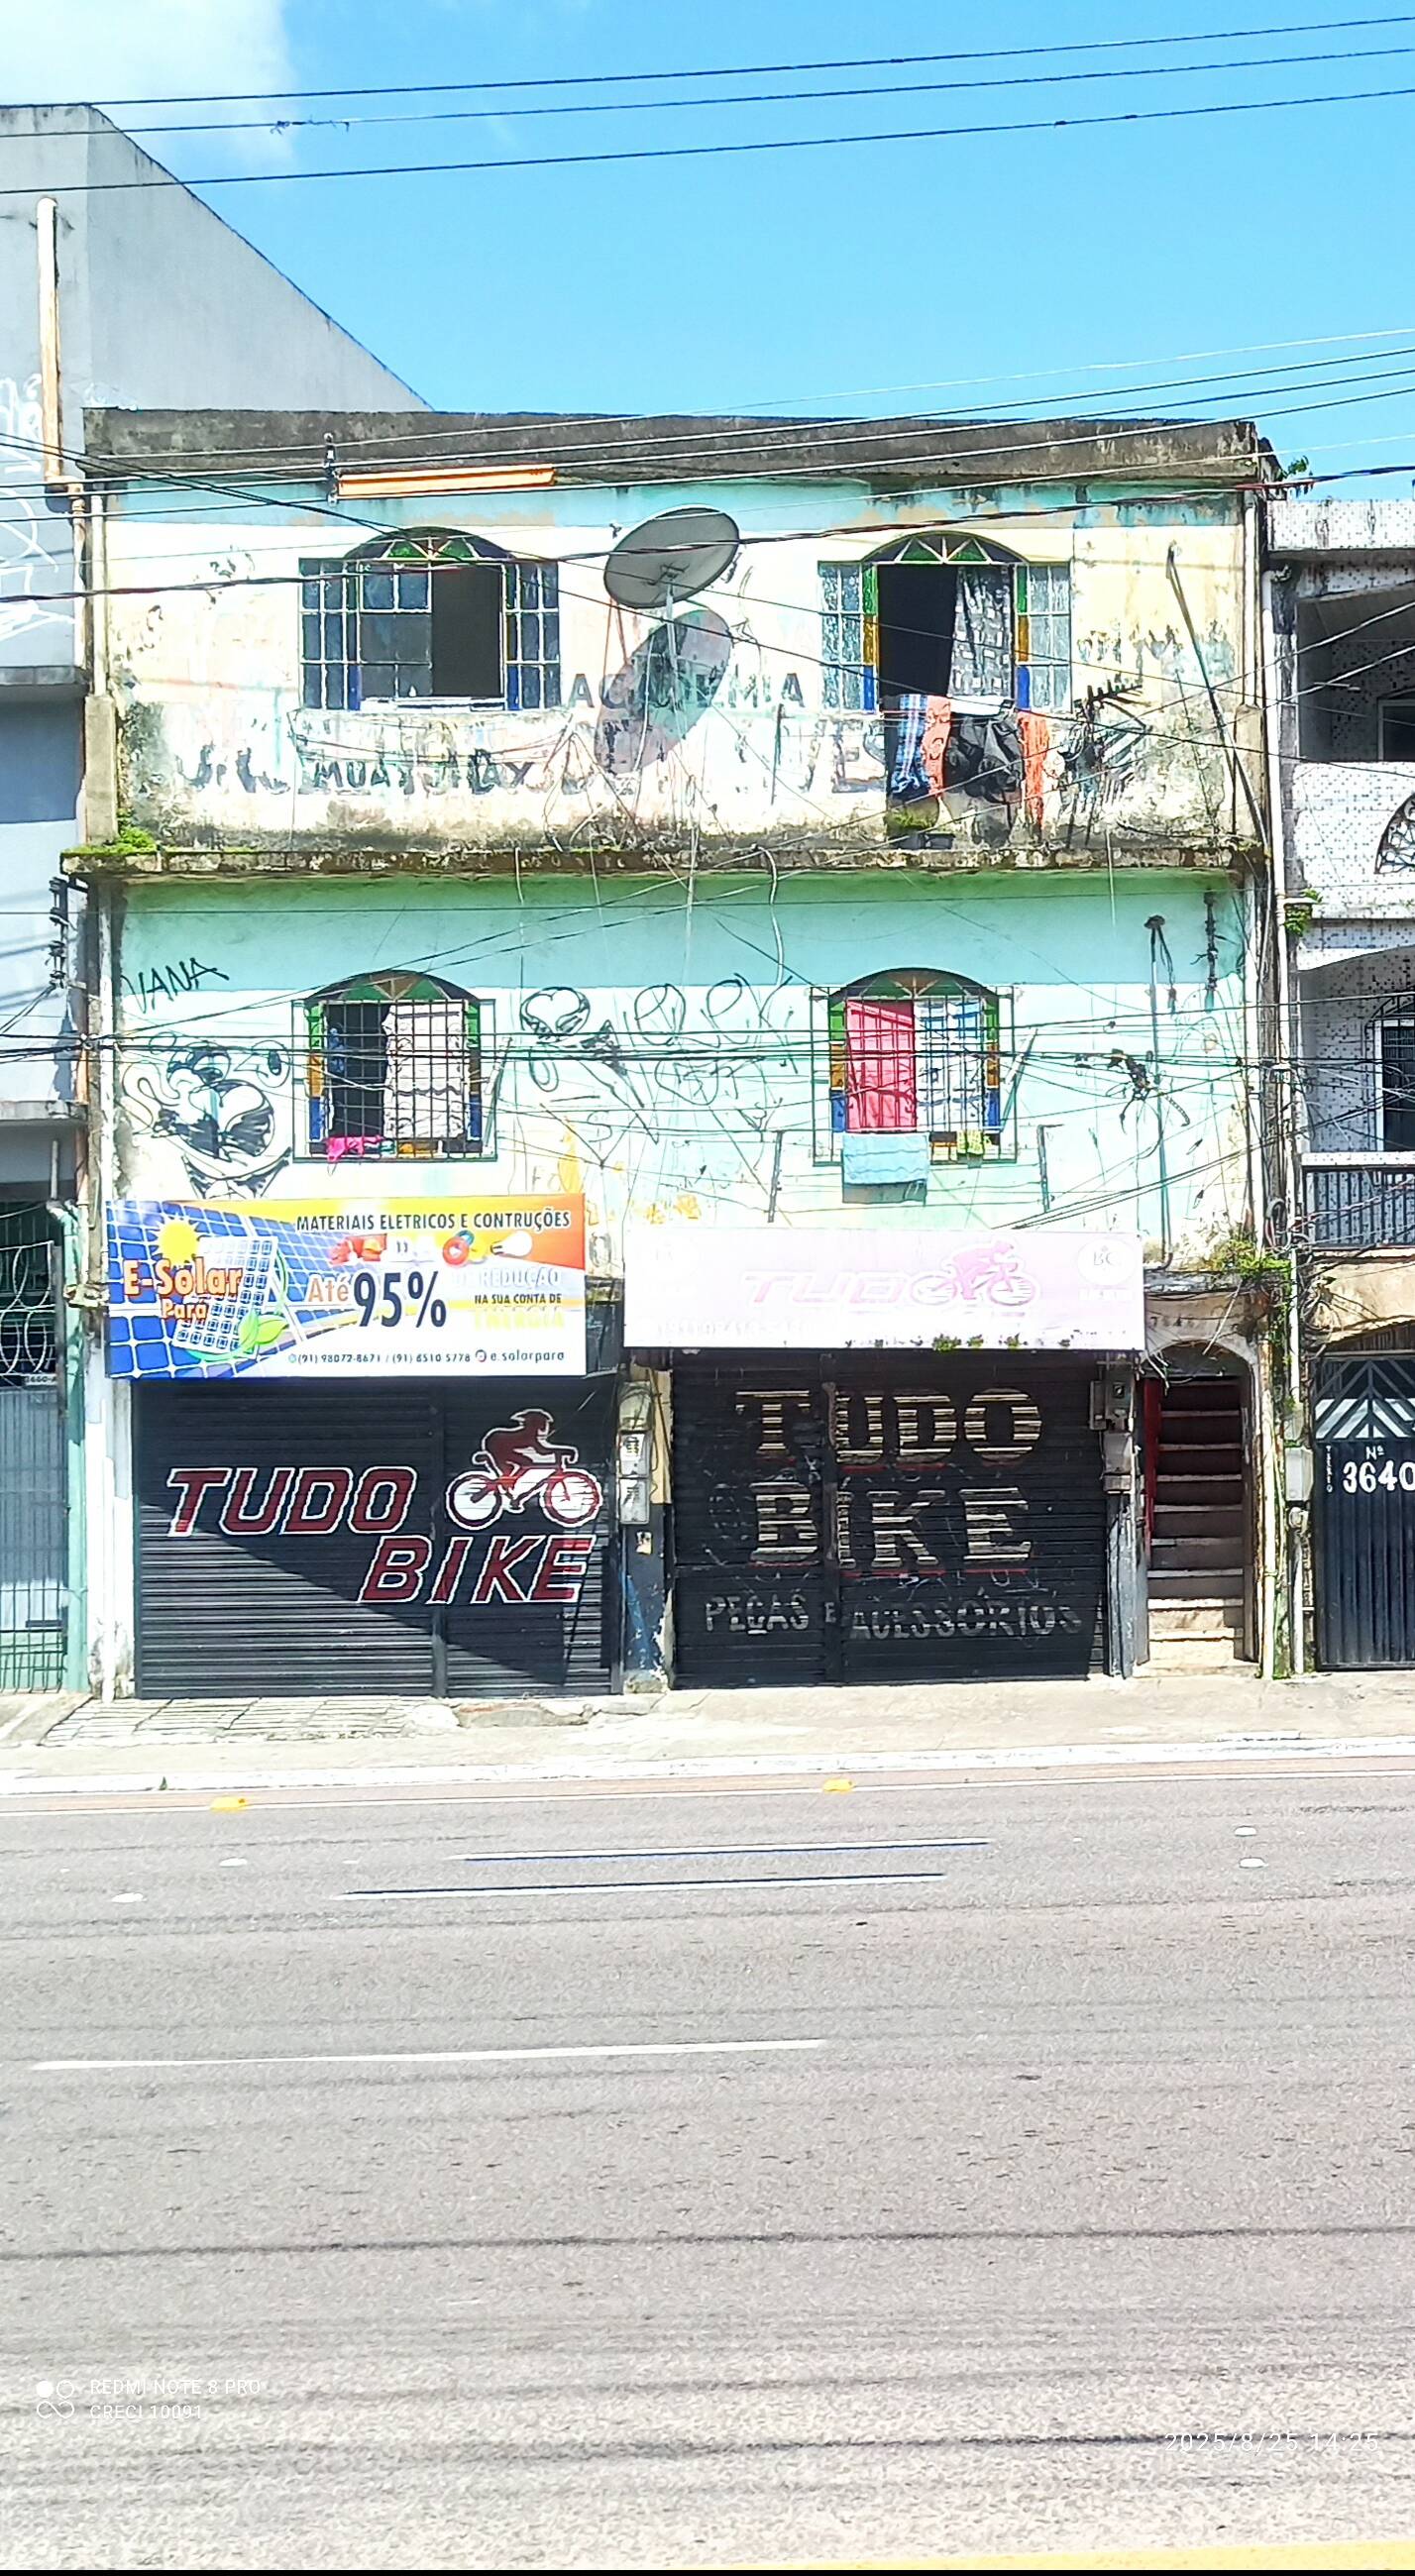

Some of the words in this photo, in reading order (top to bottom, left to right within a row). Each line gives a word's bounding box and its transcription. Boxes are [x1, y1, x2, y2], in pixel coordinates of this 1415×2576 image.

[296, 1215, 375, 1232] MATERIAIS
[380, 1213, 455, 1230] ELETRICOS
[461, 1213, 468, 1228] E
[474, 1207, 571, 1232] CONTRUÇÕES
[122, 1255, 244, 1297] E-Solar
[307, 1275, 349, 1303] Até
[353, 1270, 447, 1329] 95%
[474, 1294, 489, 1304] NA
[490, 1294, 510, 1304] SUA
[512, 1293, 546, 1304] CONTA
[549, 1293, 562, 1304] DE
[736, 1388, 1042, 1468] TUDO
[166, 1465, 417, 1537] TUDO
[1343, 1459, 1415, 1494] 3640
[748, 1482, 1033, 1579] BIKE
[357, 1534, 595, 1605] BIKE
